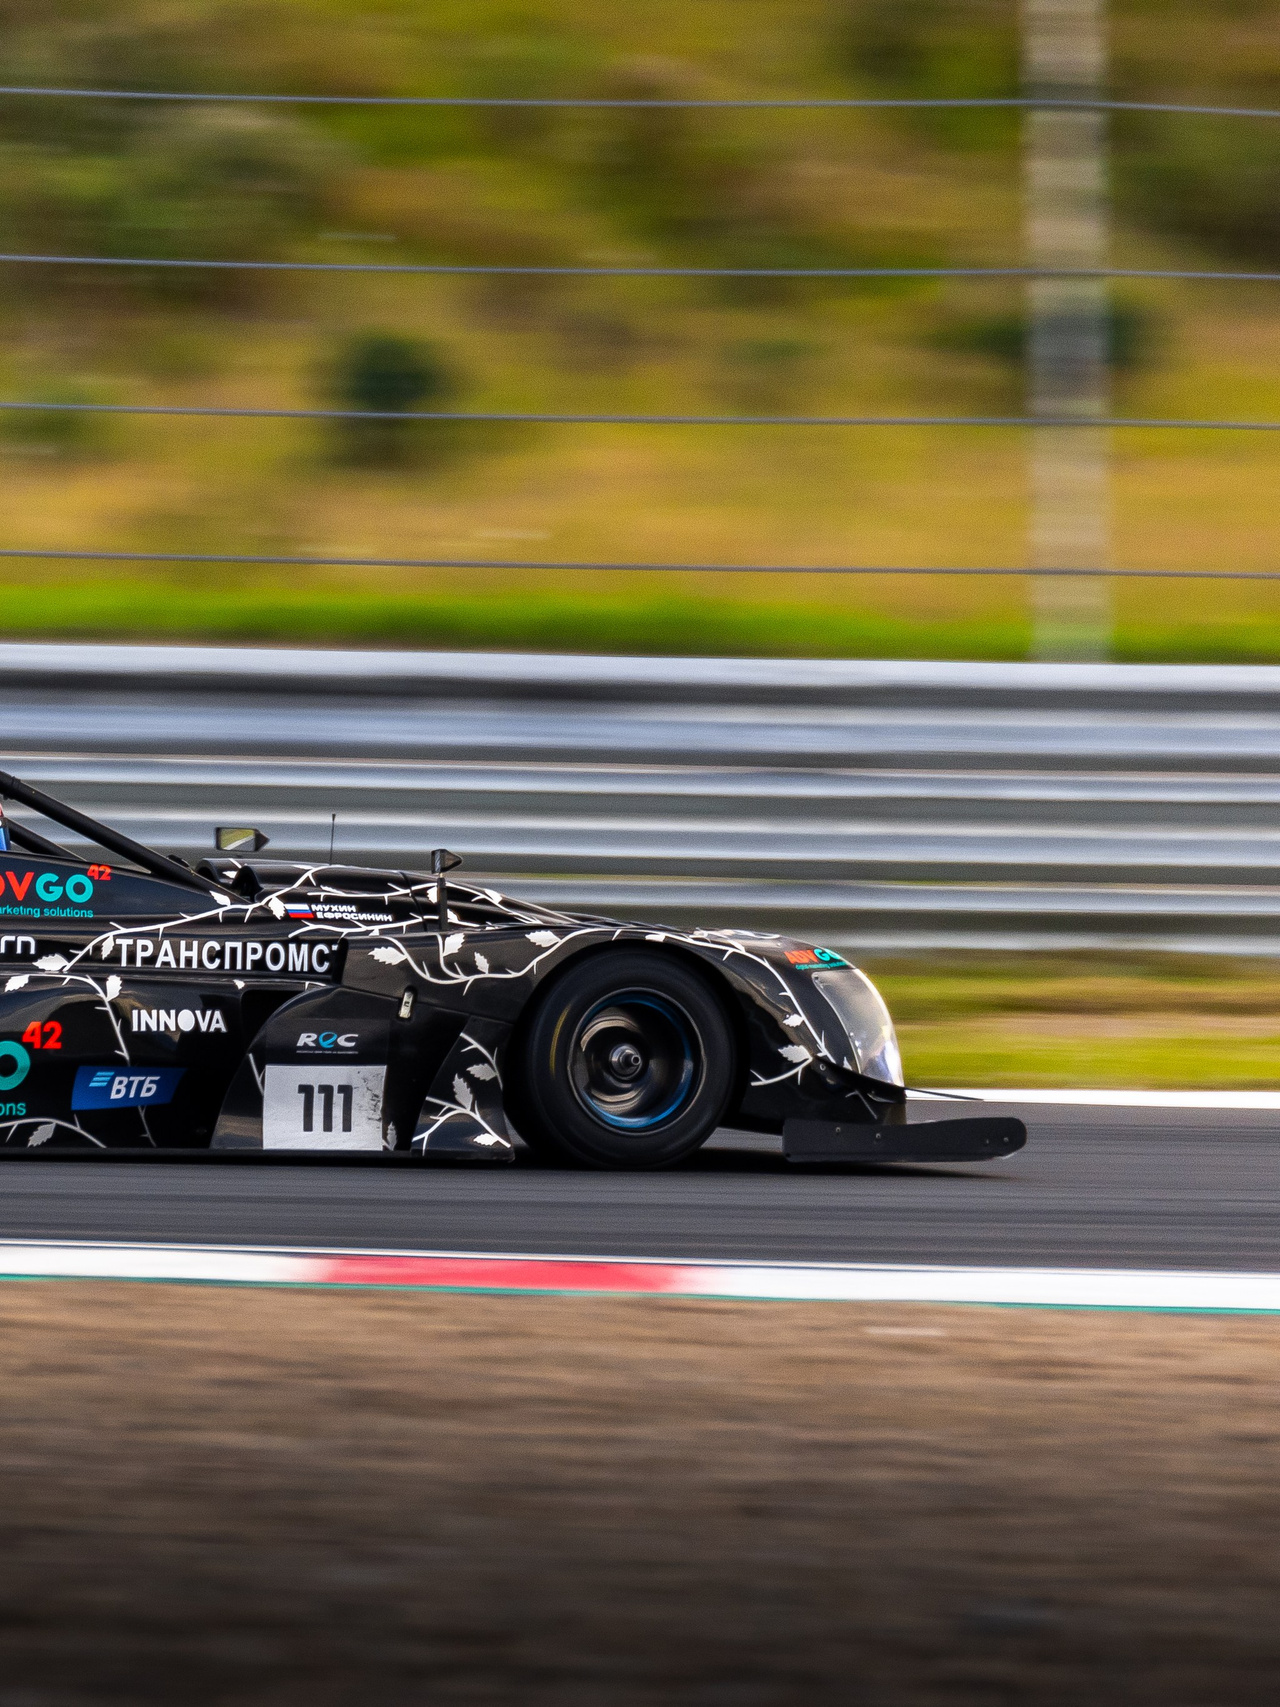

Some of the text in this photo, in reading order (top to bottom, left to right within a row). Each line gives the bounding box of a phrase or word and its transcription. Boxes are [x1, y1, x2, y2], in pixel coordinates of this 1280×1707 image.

[43, 907, 94, 918] solutions
[115, 938, 338, 973] ТРАНСПРОМС
[131, 1009, 228, 1033] INNOVA
[109, 1076, 161, 1099] ВТБ
[297, 1084, 354, 1133] 111
